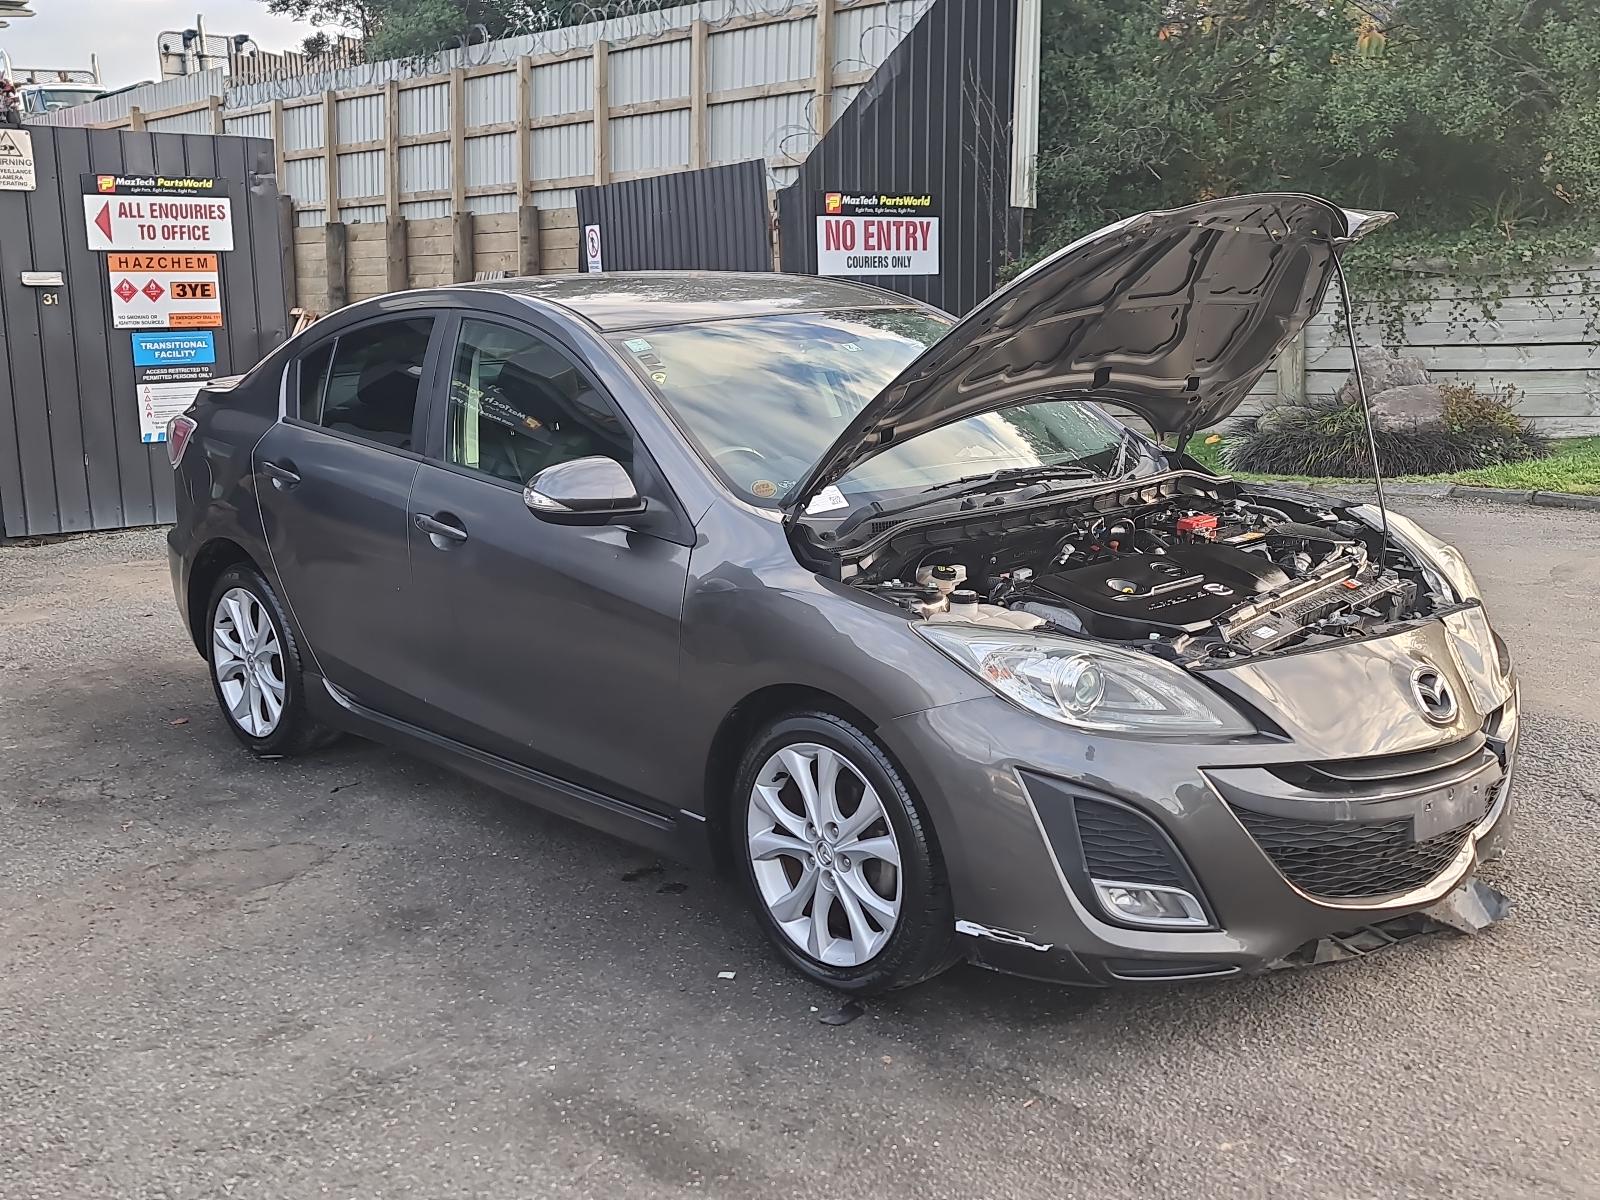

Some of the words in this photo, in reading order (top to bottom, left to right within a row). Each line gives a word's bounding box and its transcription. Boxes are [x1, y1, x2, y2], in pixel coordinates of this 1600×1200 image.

[0, 158, 33, 167] RNING
[115, 177, 155, 187] MazTech
[157, 178, 213, 189] PartsWorld
[841, 195, 878, 206] MazTech
[879, 195, 931, 207] PartsWorld
[118, 201, 145, 219] ALL
[149, 203, 226, 221] ENQUIRIES
[138, 224, 157, 241] TO
[161, 224, 211, 241] OFFICE
[825, 219, 856, 252] NO
[863, 219, 931, 252] ENTRY
[118, 256, 208, 270] HAZCHEM
[846, 255, 889, 269] COURIERS
[891, 255, 912, 269] ONLY
[175, 283, 212, 298] 3YE
[42, 293, 59, 305] 31
[140, 340, 208, 350] TRANSITIONAL
[154, 350, 196, 359] FACILITY
